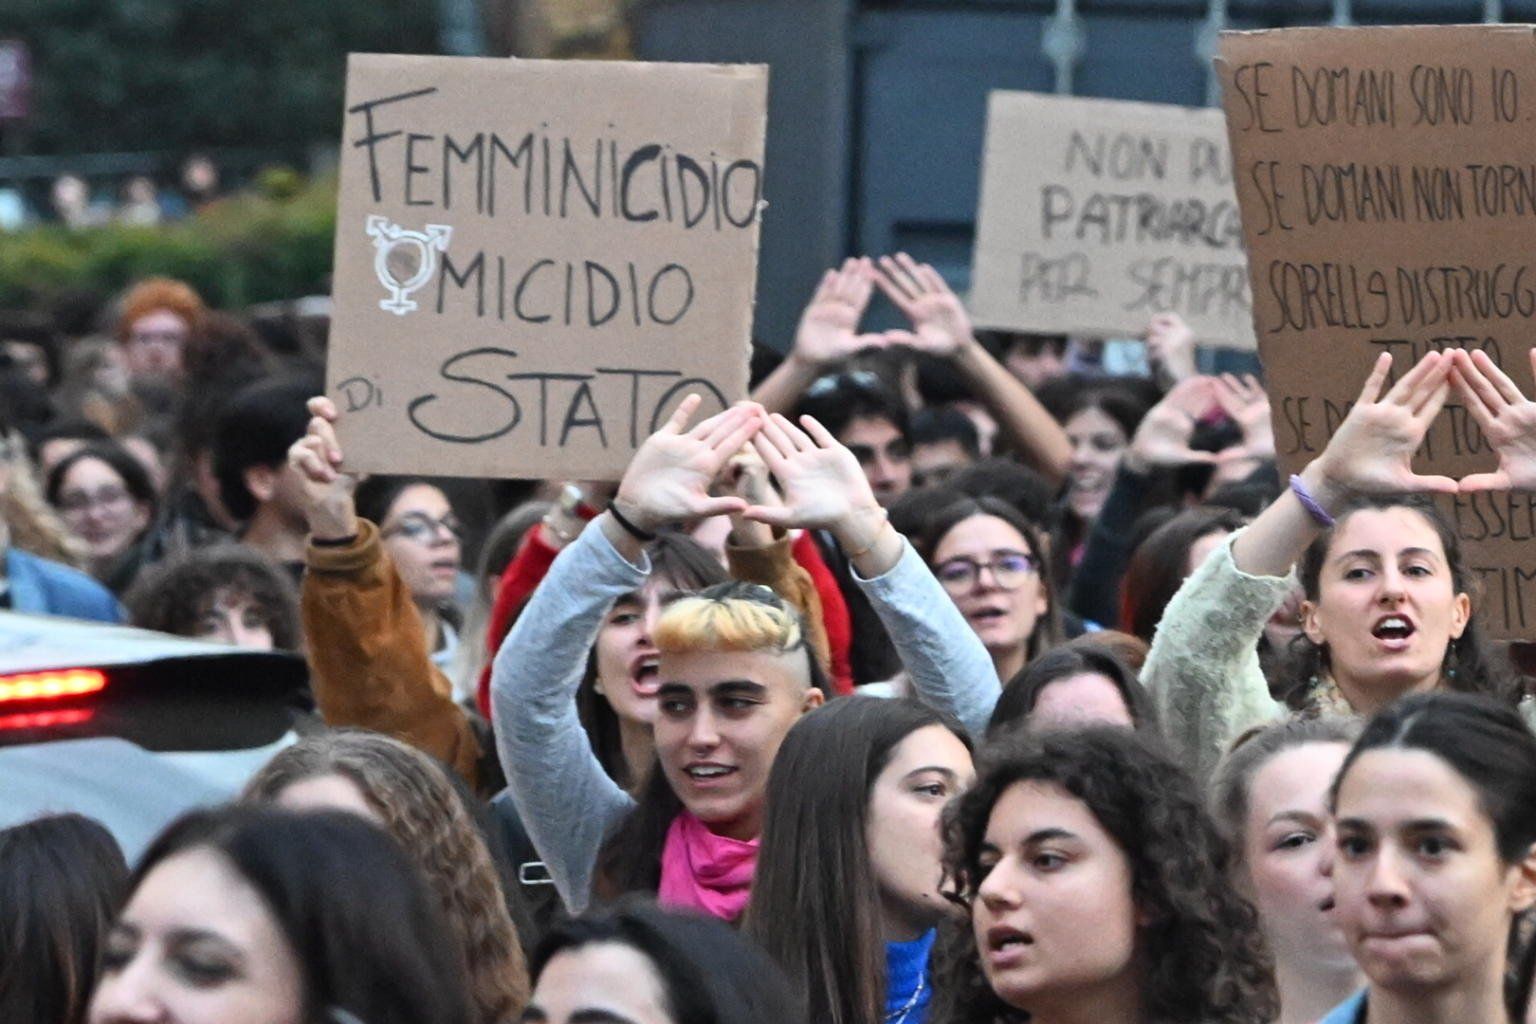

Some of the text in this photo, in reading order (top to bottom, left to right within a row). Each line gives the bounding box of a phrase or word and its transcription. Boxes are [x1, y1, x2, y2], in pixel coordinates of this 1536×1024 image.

[1234, 62, 1283, 132] SE
[1292, 65, 1396, 129] DOMANI
[1410, 64, 1473, 126] SONO
[1065, 130, 1169, 180] NON
[1041, 184, 1242, 248] PATRIARCA
[1251, 161, 1292, 236] SE
[1302, 162, 1407, 226] DOMANI
[1411, 164, 1465, 222] NON
[1121, 256, 1252, 316] SEMPR
[407, 347, 730, 447] STATO
[1283, 396, 1316, 455] SE
